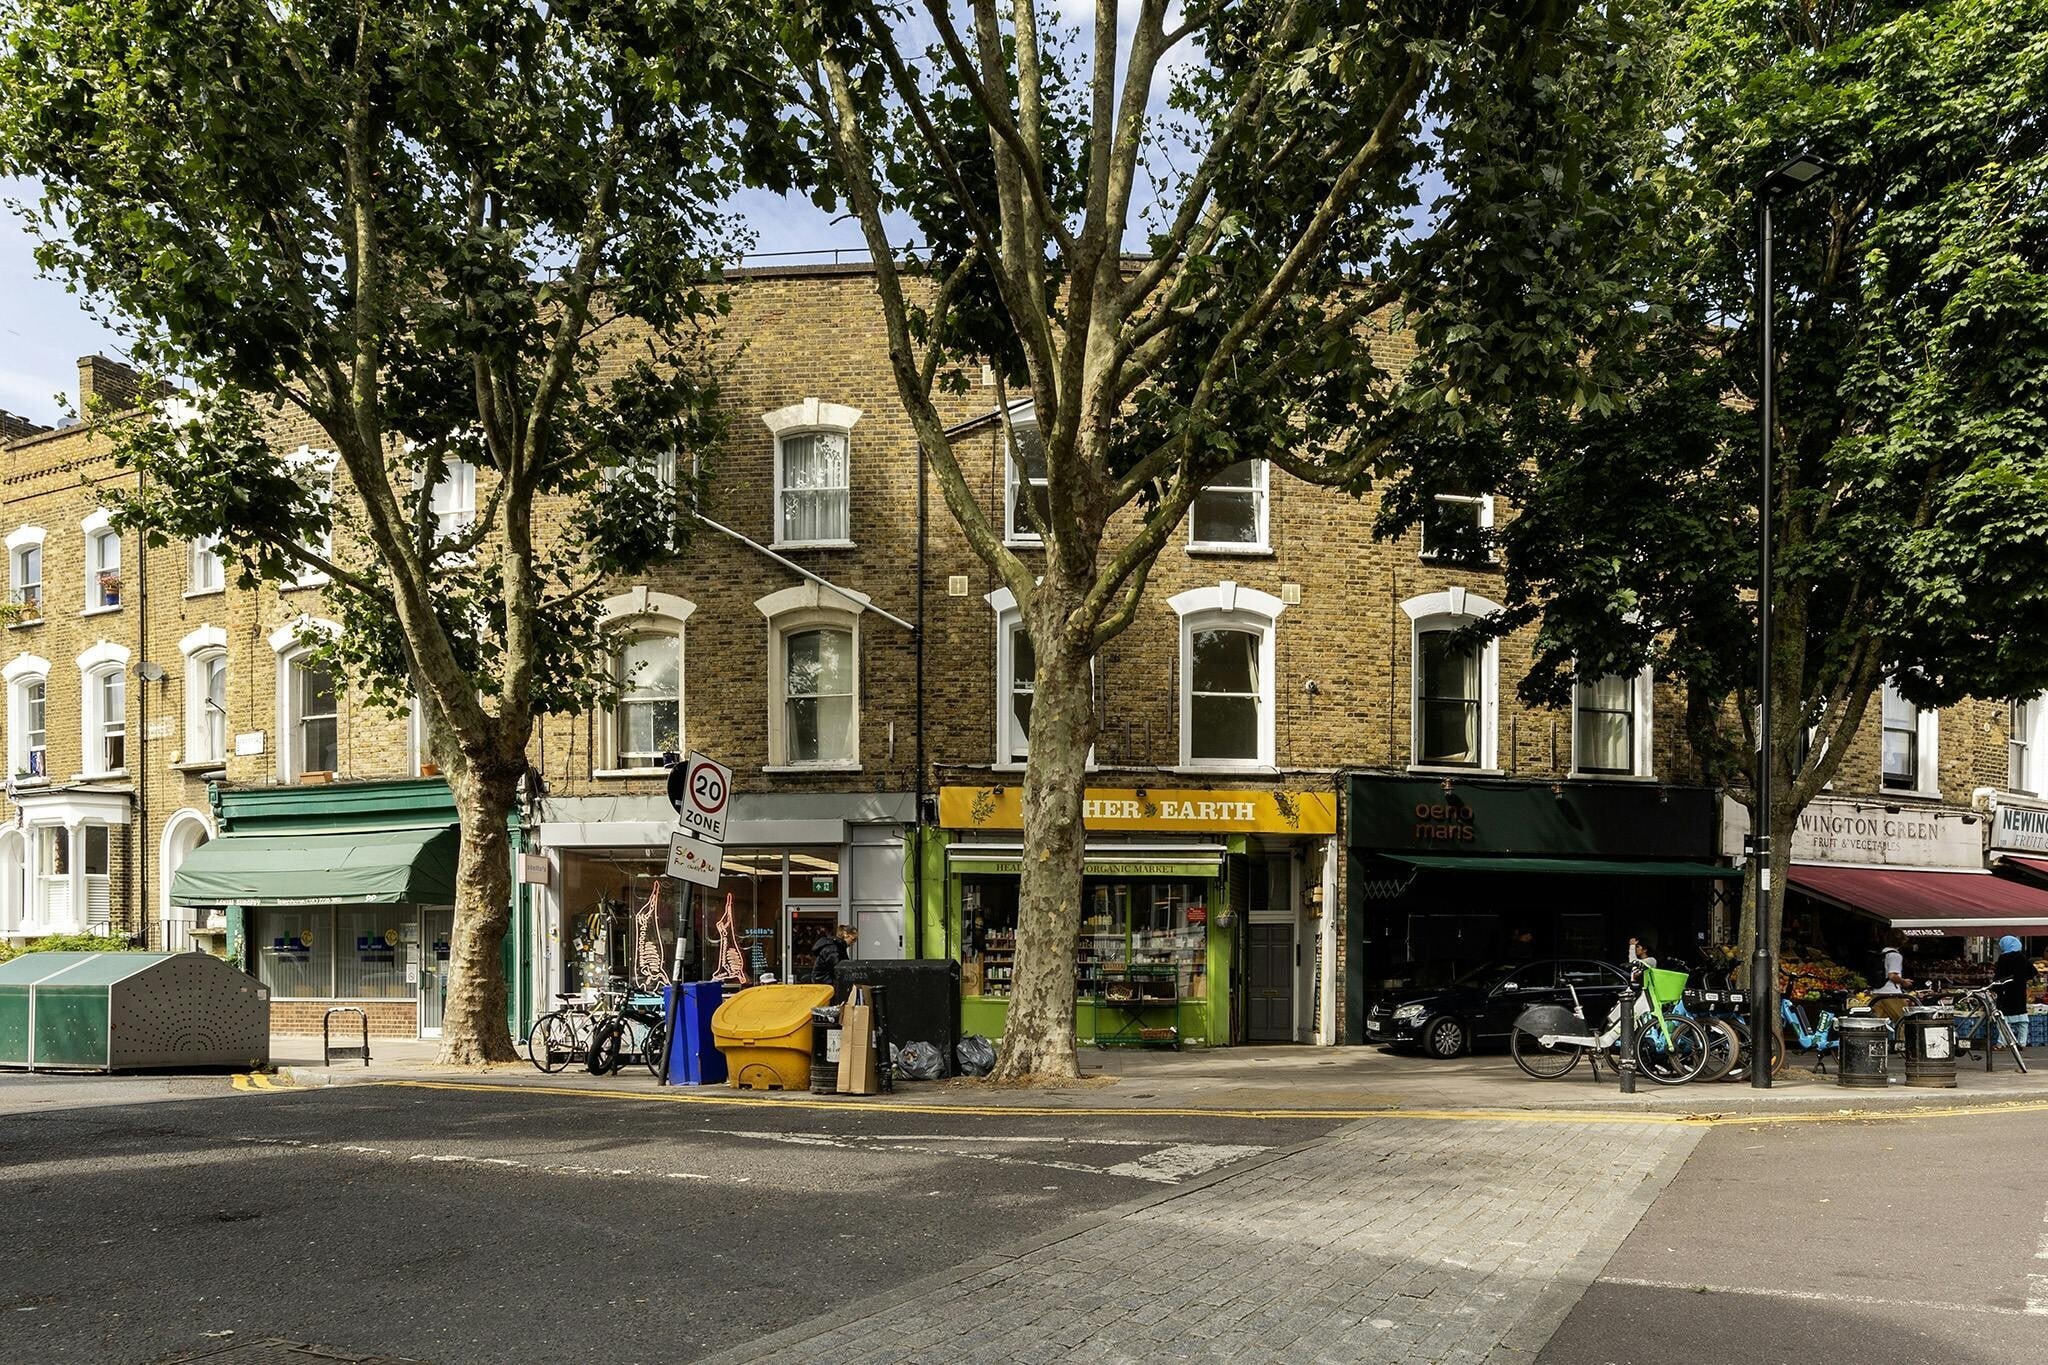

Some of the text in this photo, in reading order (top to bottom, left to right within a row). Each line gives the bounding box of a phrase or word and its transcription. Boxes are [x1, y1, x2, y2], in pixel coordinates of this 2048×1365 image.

[695, 775, 722, 801] 20
[1160, 801, 1255, 821] EARTH
[1415, 803, 1473, 819] oeno
[685, 809, 721, 834] ZONE
[1415, 820, 1474, 839] maris
[1795, 814, 1878, 836] WINGTON
[1813, 837, 1838, 848] FRUIT
[1851, 839, 1902, 852] VEGETABLES
[2013, 834, 2043, 849] FRUIT
[1085, 864, 1131, 873] ORGANIC
[1134, 865, 1175, 874] MARKET
